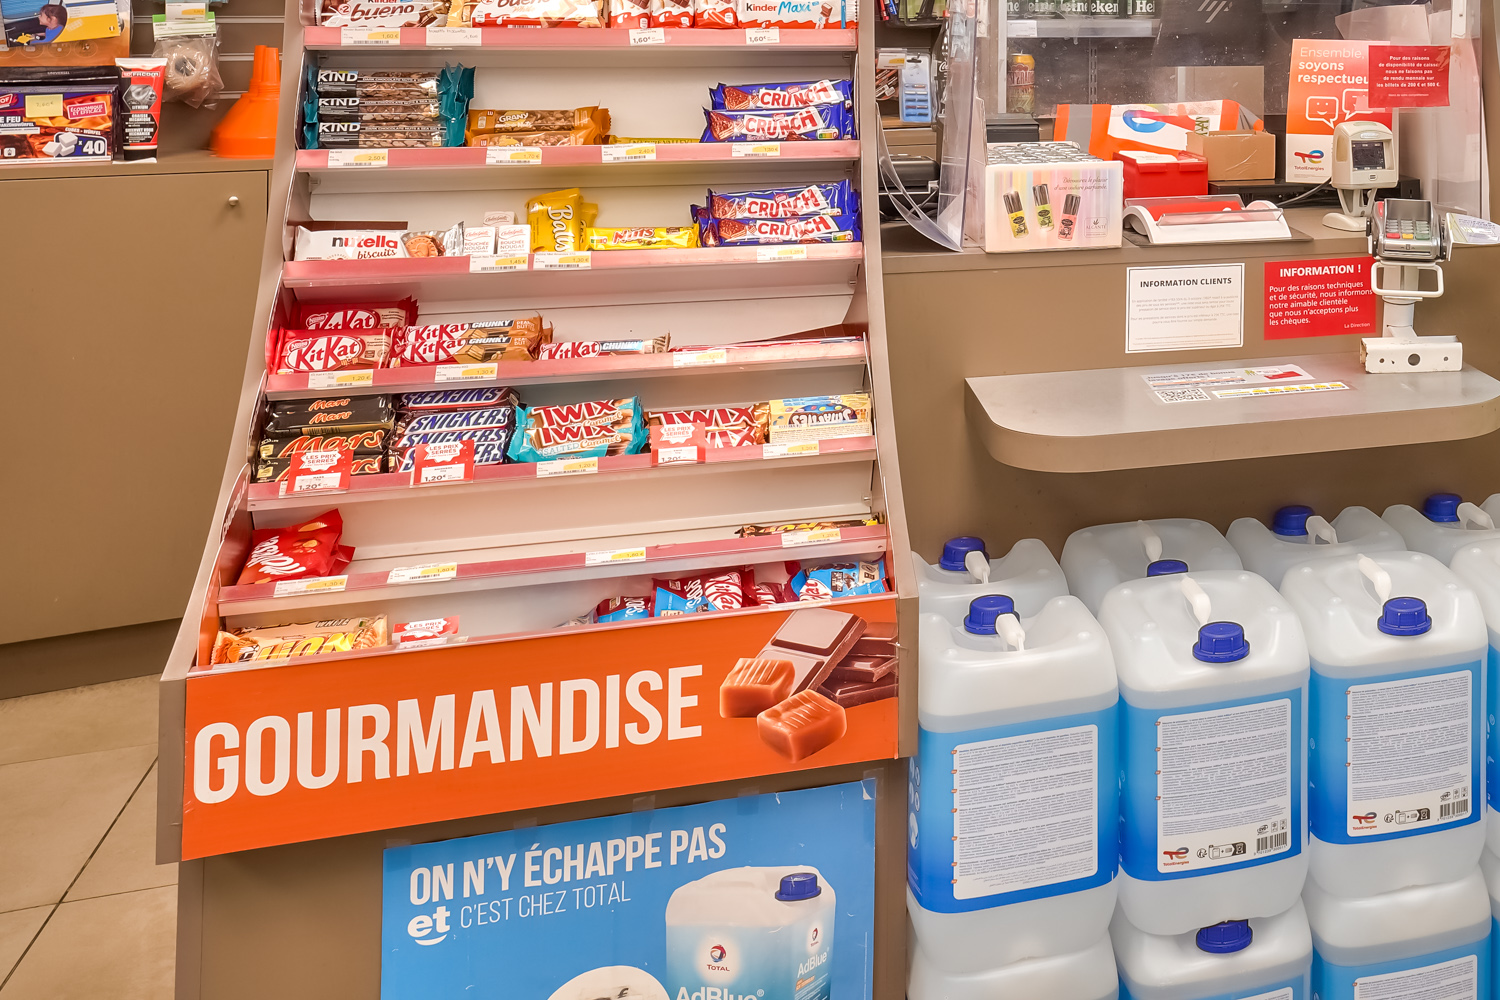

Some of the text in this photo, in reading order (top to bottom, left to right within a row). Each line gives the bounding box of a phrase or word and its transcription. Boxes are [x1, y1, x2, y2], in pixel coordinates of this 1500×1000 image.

[1300, 48, 1365, 59] Ensemble,
[1298, 61, 1344, 73] soyons
[317, 72, 357, 82] KIND
[760, 81, 831, 107] CRUNCH
[745, 109, 818, 135] CRUNCH
[83, 140, 104, 154] 40
[332, 234, 398, 248] nutella
[357, 249, 397, 259] biscuits
[1280, 265, 1352, 278] INFORMATION
[1140, 277, 1232, 288] INFORMATION CLIENTS
[1301, 283, 1322, 291] raisons
[1324, 281, 1363, 290] techniques
[1289, 291, 1318, 300] sécurité,
[1320, 290, 1337, 298] nous
[1338, 288, 1372, 297] informons
[1290, 300, 1316, 308] aimable
[1319, 298, 1348, 306] clientèle
[1302, 307, 1342, 318] n'acceptons
[1344, 306, 1359, 315] plus
[1281, 316, 1311, 326] chèques.
[415, 320, 511, 343] KitKat CHUNKY
[293, 336, 362, 370] KitKat
[309, 399, 350, 411] Mars
[413, 409, 510, 430] SNICKERS
[194, 665, 703, 805] GOURMANDISE
[409, 823, 726, 905] ON N'Y ÉCHAPPE PAS
[407, 881, 631, 938] et C'EST CHEZ TOTAL
[797, 951, 827, 978] AdBlue
